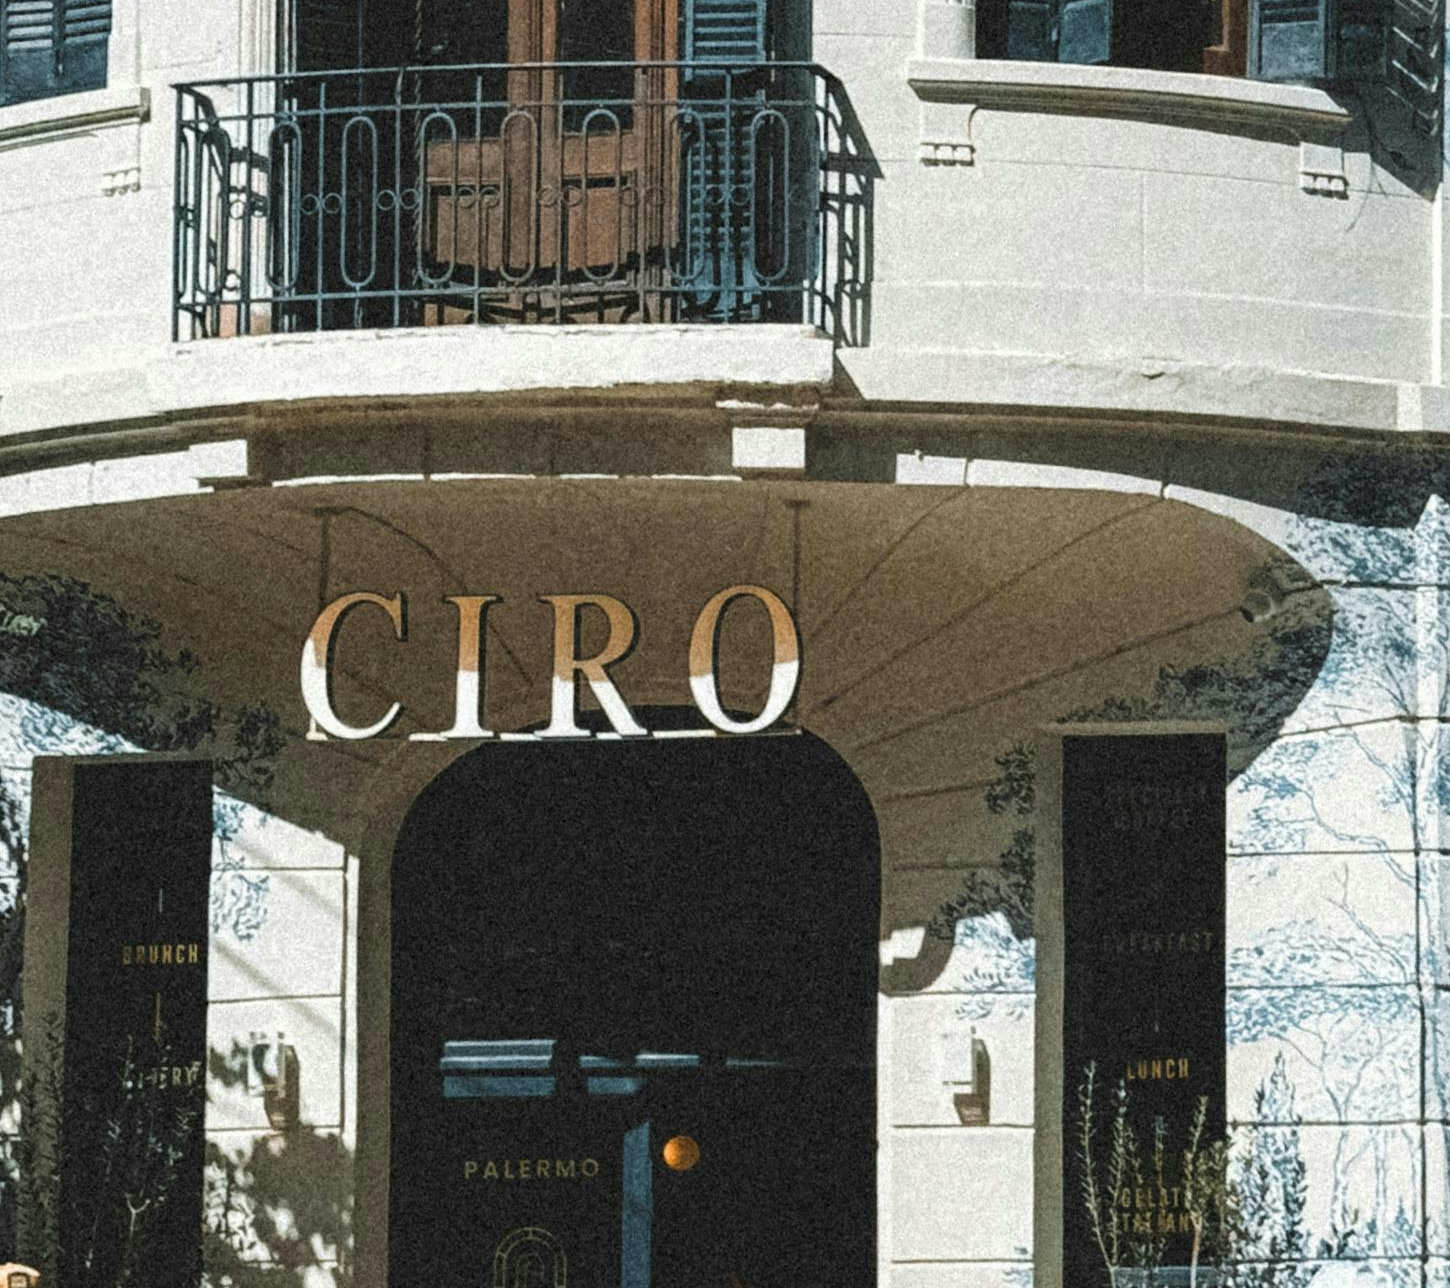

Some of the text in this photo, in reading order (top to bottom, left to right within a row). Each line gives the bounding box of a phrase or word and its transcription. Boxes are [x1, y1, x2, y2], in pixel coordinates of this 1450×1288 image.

[301, 584, 800, 739] CIRO
[123, 943, 198, 965] BRUNCH
[1127, 1057, 1189, 1080] LUNCH
[464, 1158, 600, 1180] PALERMO
[1121, 1186, 1193, 1209] GELAT
